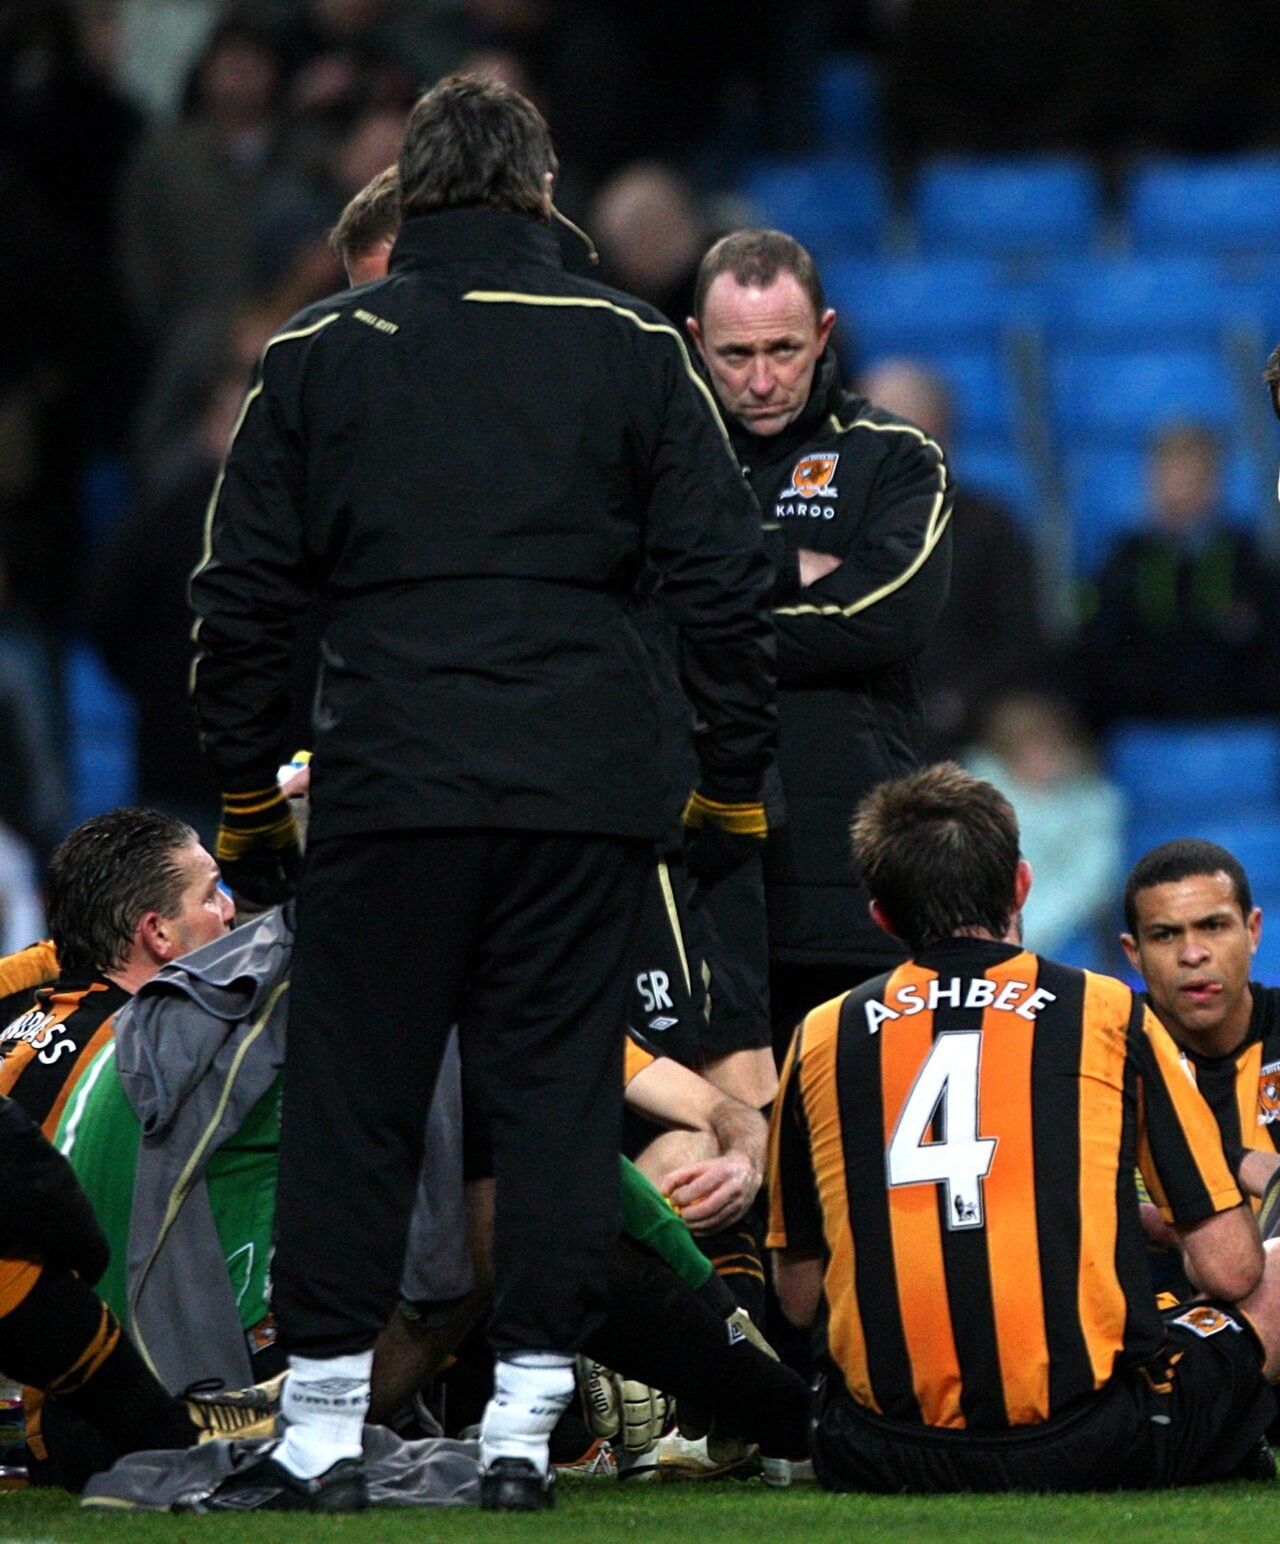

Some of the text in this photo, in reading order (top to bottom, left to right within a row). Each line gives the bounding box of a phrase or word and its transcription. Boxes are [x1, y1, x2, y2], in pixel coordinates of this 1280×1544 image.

[776, 503, 835, 519] KAROO
[636, 970, 674, 1012] SR
[864, 977, 1057, 1034] ASHBEE
[887, 1030, 999, 1231] 4
